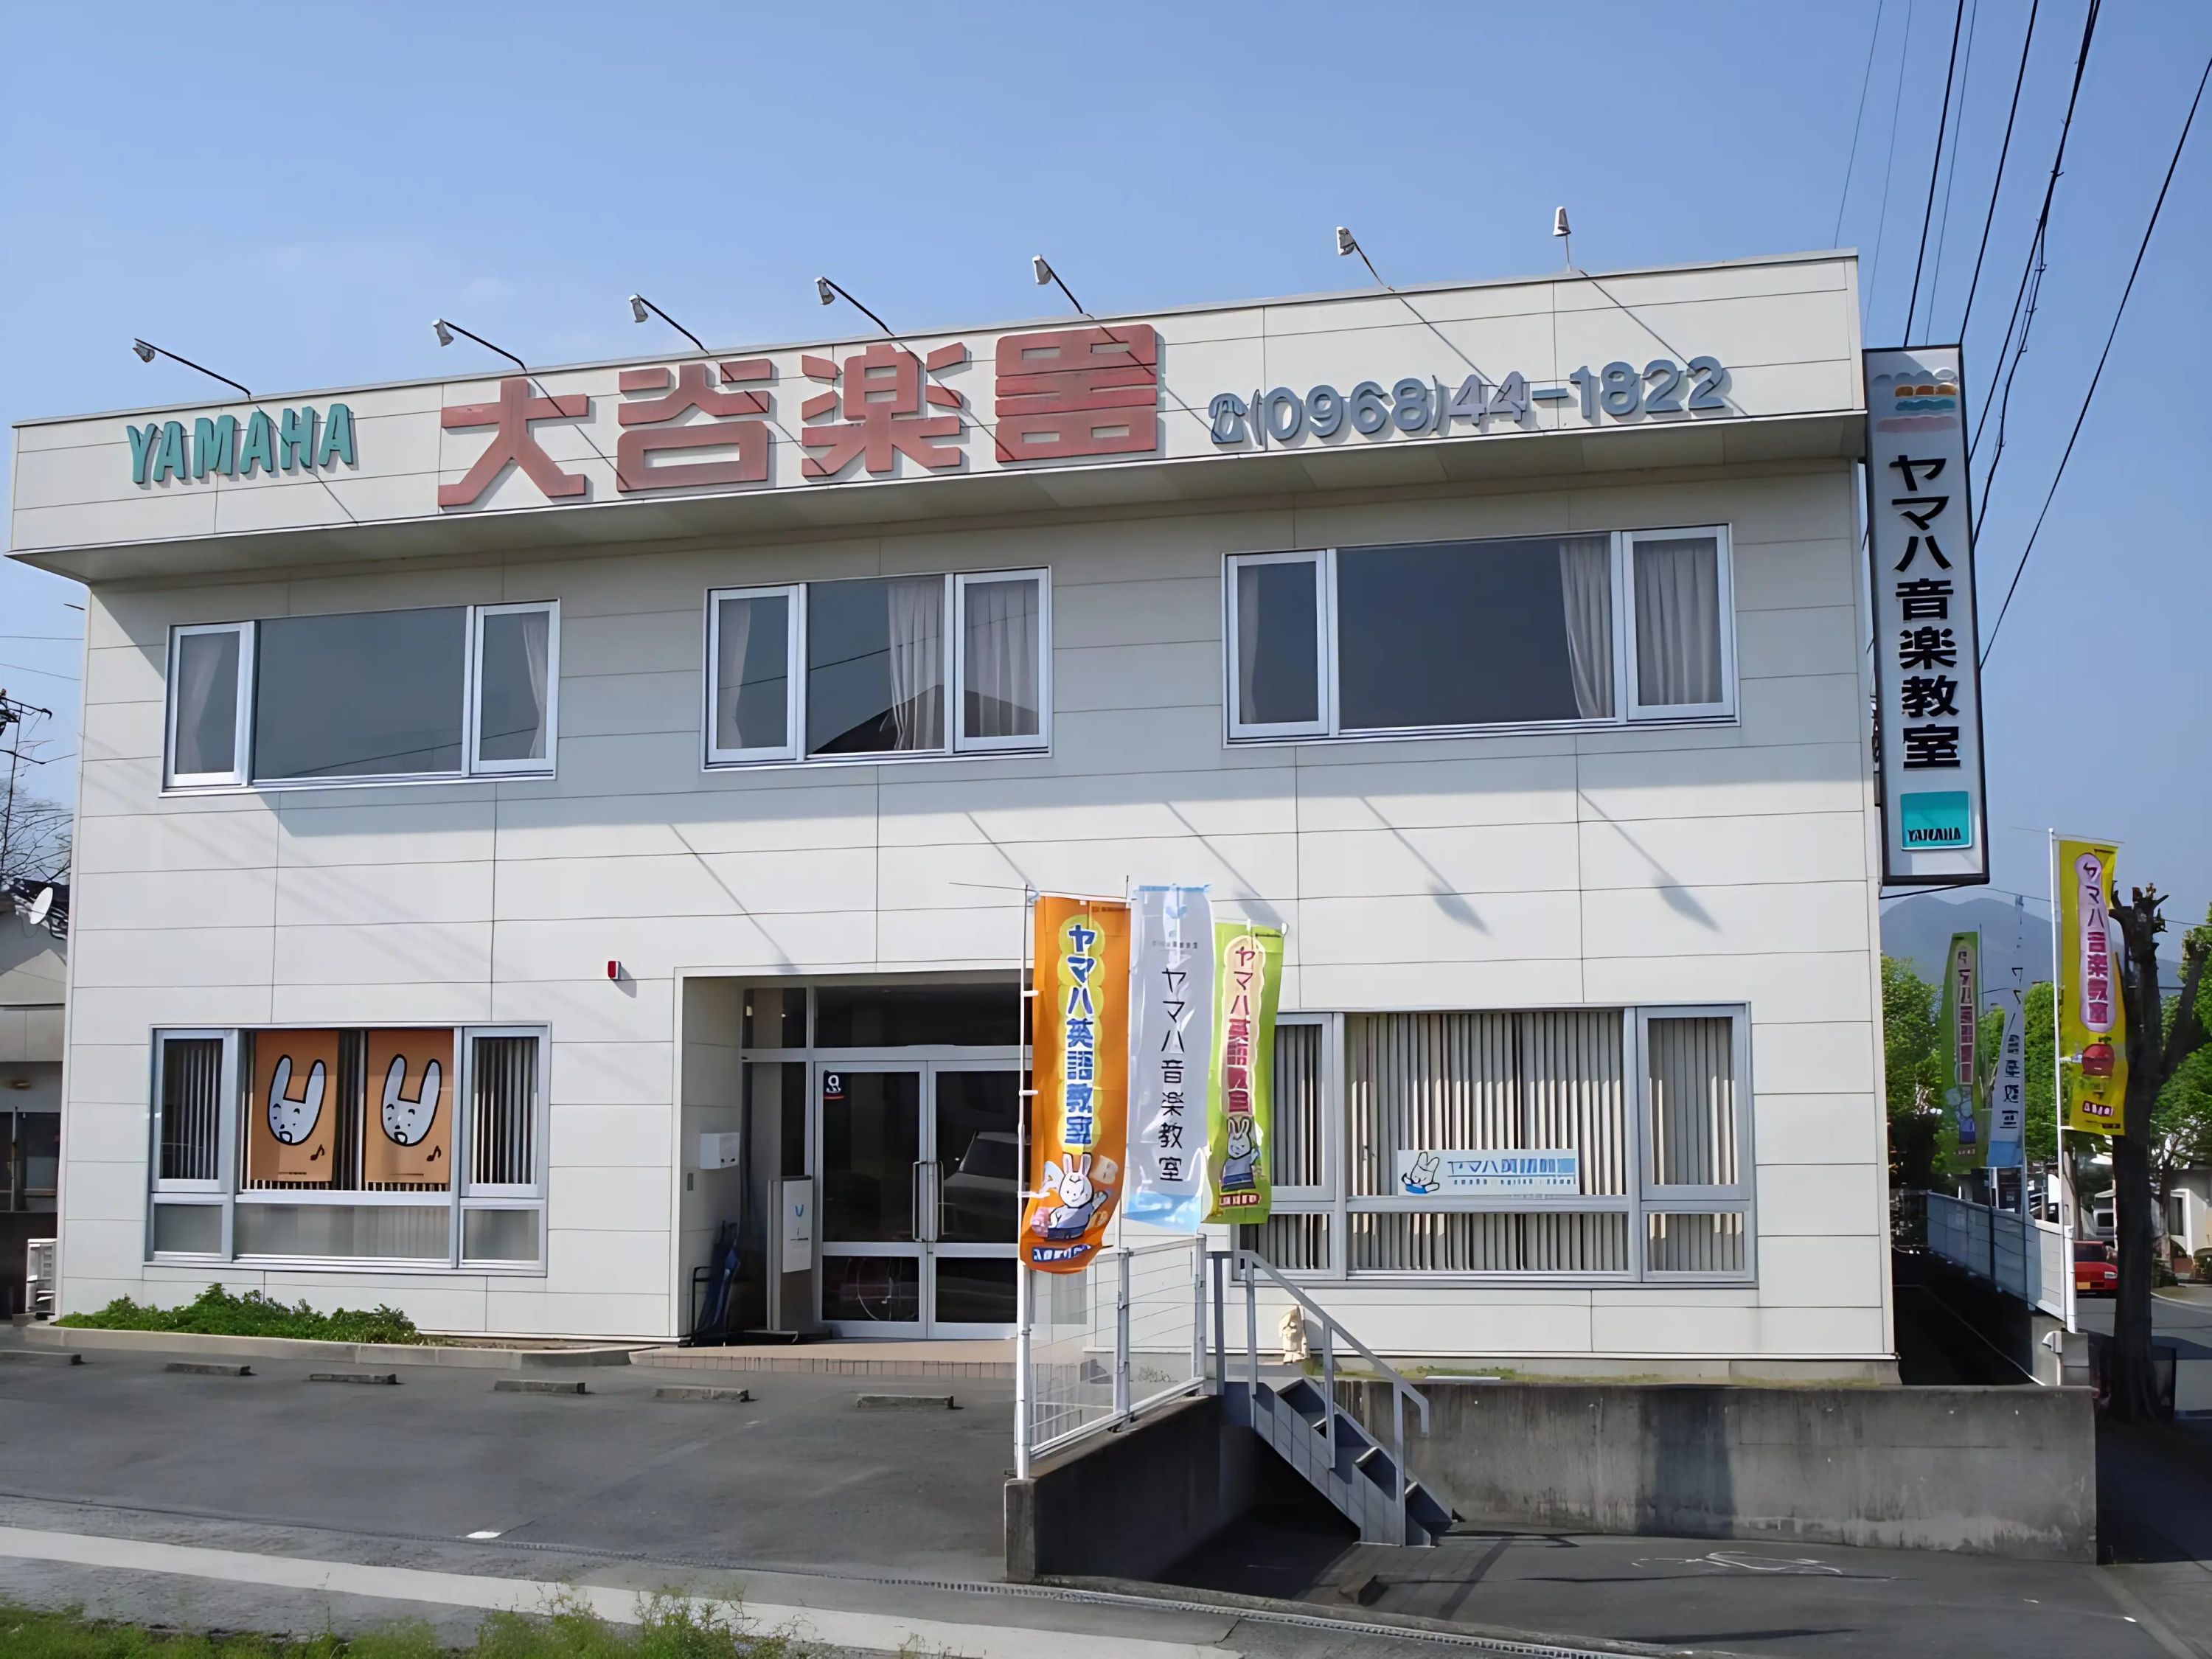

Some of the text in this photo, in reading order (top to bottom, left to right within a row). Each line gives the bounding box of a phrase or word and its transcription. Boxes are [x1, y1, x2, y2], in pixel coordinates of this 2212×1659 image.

[127, 403, 354, 484] YAMAHA
[438, 323, 1158, 508] 大谷楽器
[1889, 454, 1961, 769] ヤマハ音楽教室
[1158, 967, 1186, 1181] ヤマハ音楽教室
